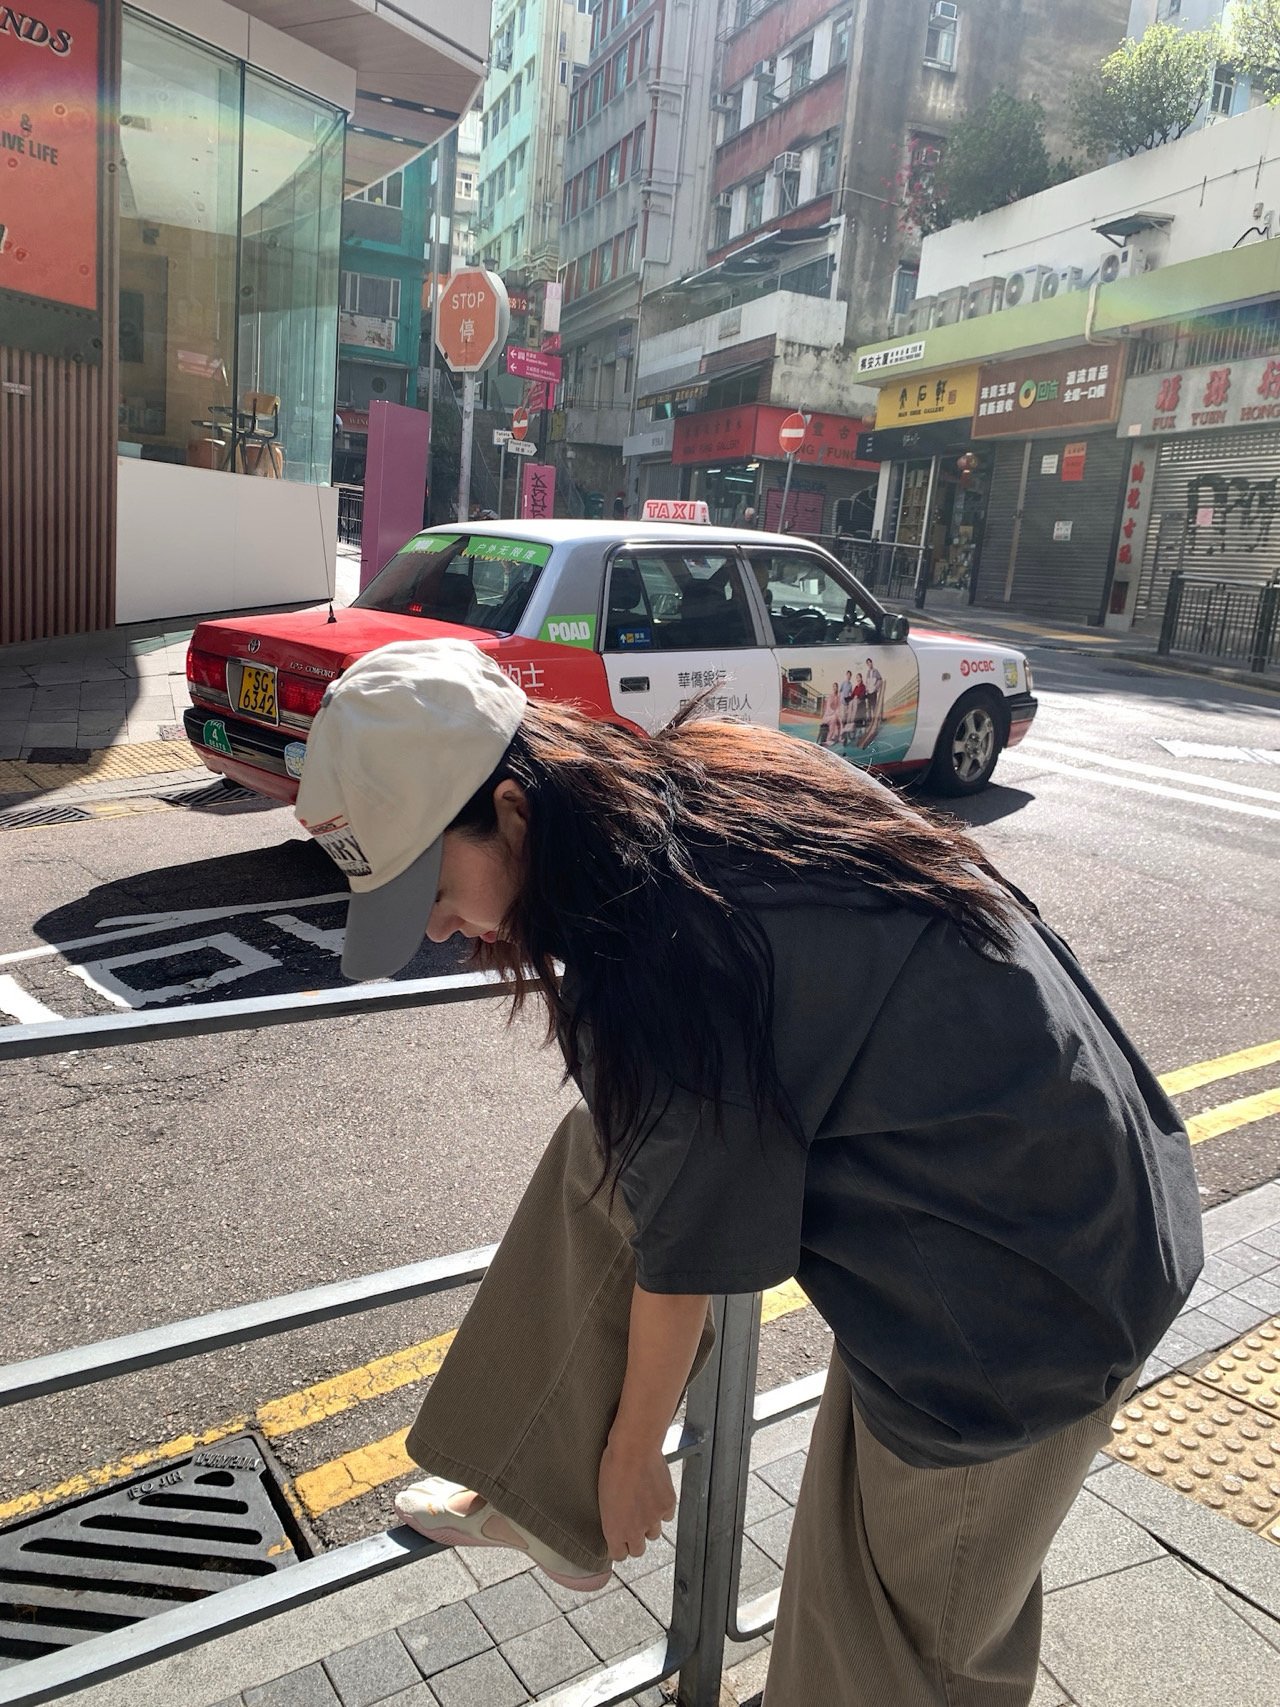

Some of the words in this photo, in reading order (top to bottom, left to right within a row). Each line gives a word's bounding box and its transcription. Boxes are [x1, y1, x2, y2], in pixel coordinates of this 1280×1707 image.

[20, 113, 32, 132] &
[0, 130, 25, 154] IVE
[28, 139, 58, 166] LIFE
[451, 291, 485, 310] STOP
[460, 318, 475, 343] 停
[646, 502, 696, 521] TAXI
[547, 621, 591, 642] POAD
[290, 661, 303, 671] LPG
[305, 666, 336, 678] COMFORT
[970, 660, 995, 673] OCBC
[253, 671, 269, 693] SG
[243, 689, 275, 716] 6342
[211, 728, 219, 741] 4
